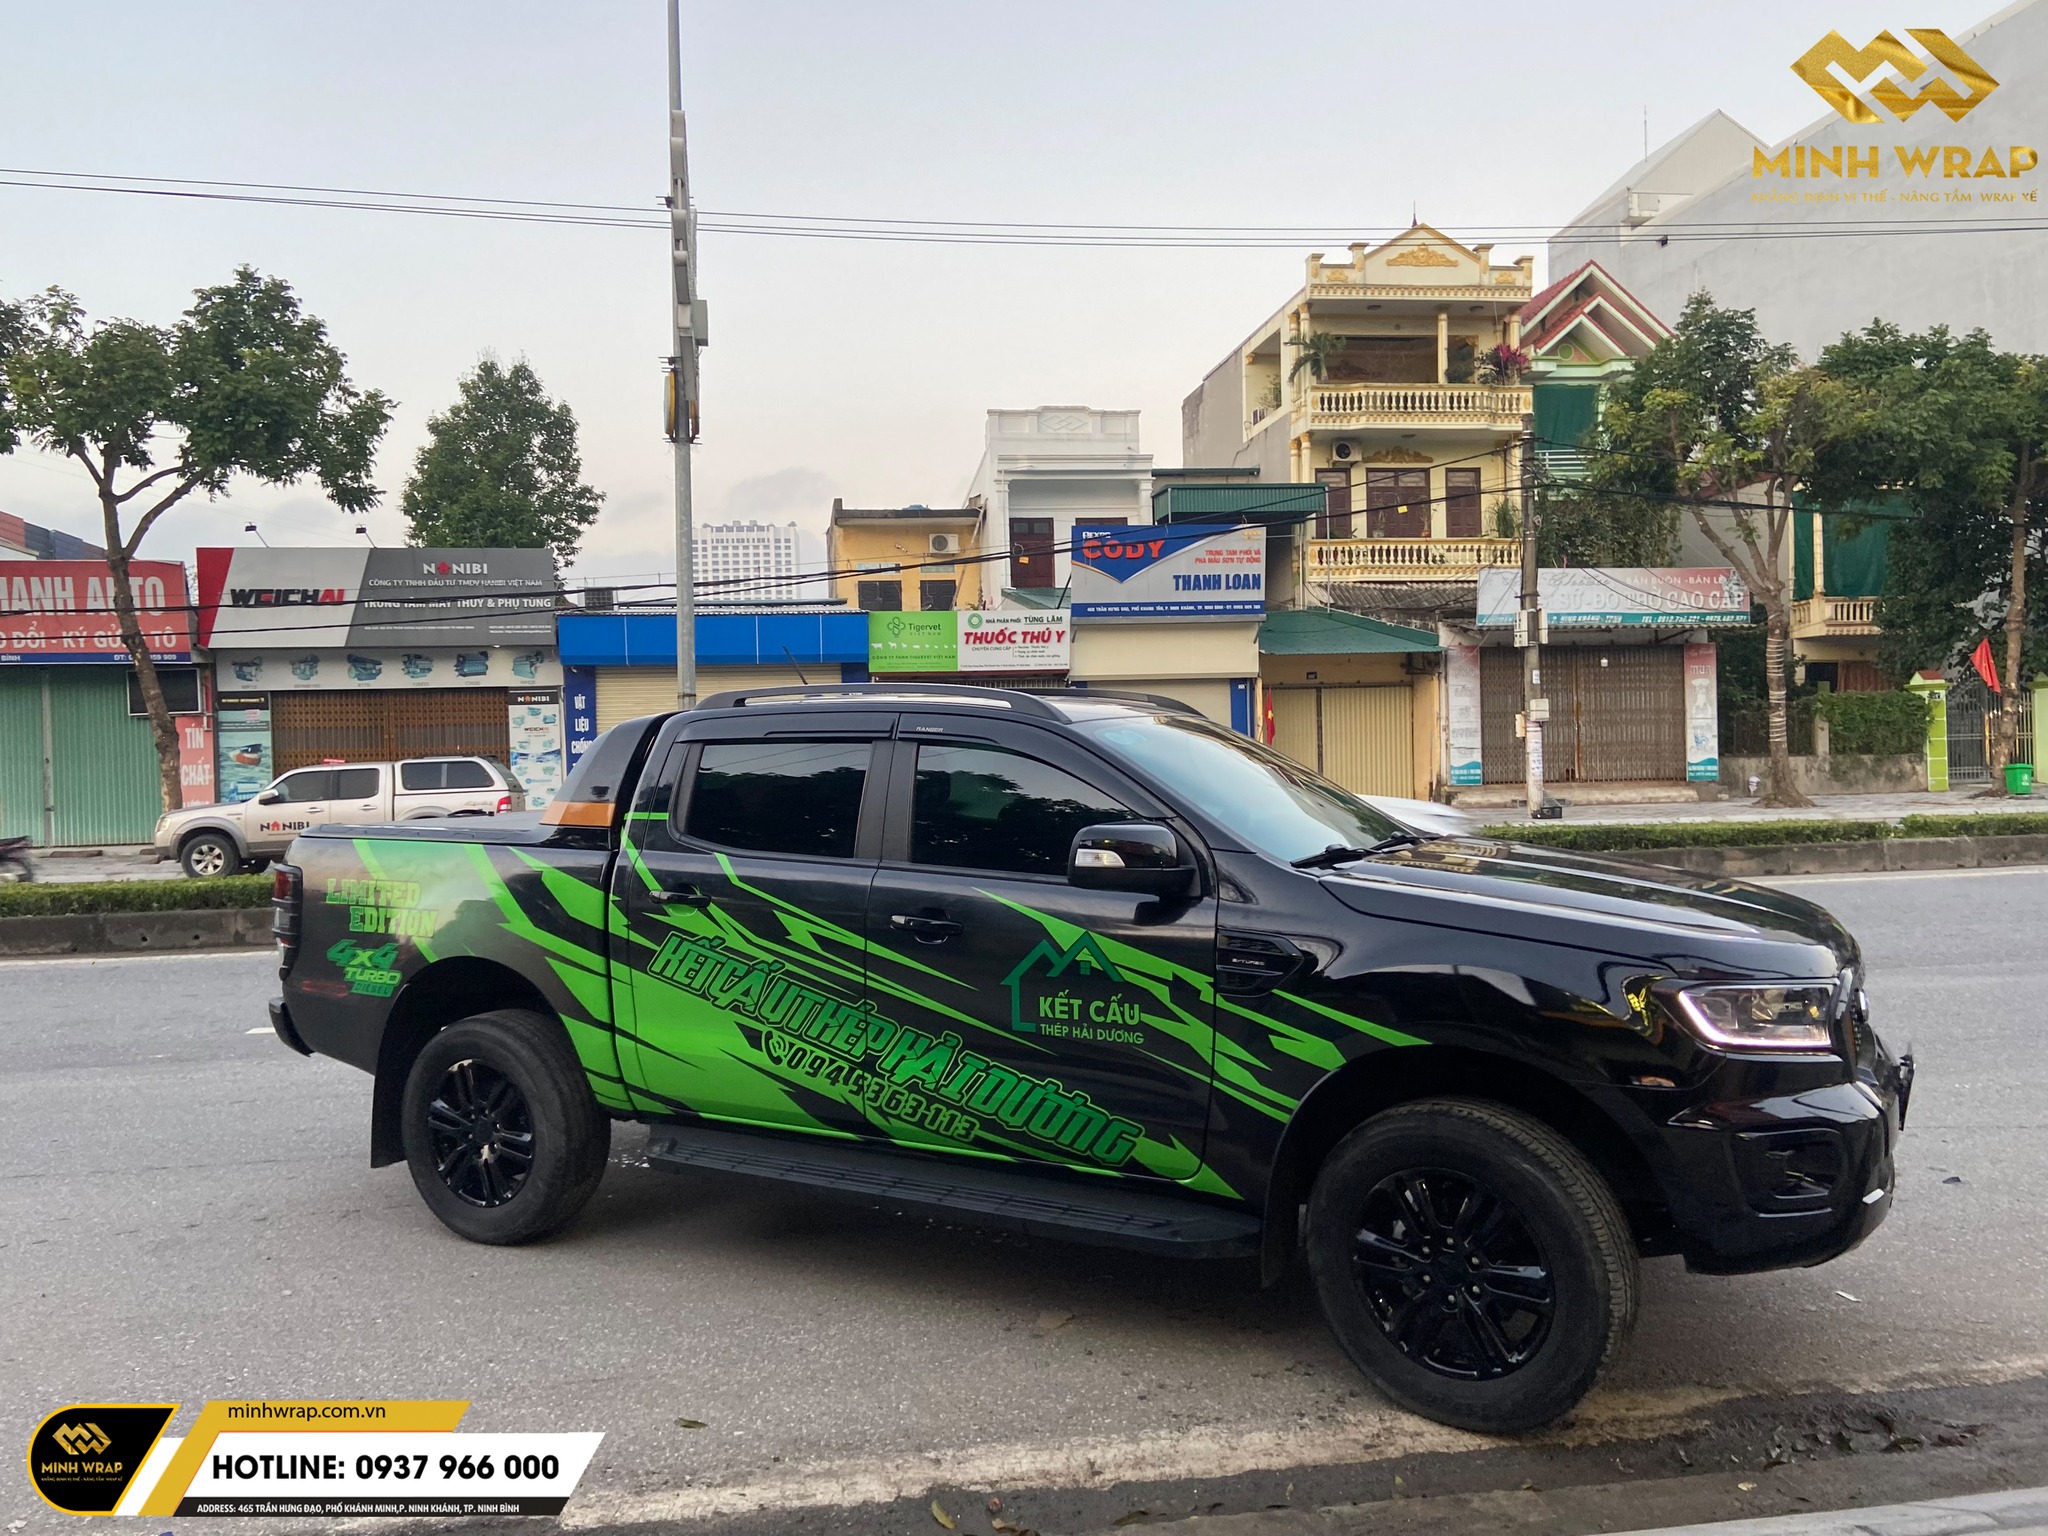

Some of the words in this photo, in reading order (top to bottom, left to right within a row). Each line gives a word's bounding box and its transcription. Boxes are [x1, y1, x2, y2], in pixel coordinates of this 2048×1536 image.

[1083, 540, 1165, 559] CODY
[368, 578, 392, 587] CÔNG
[394, 579, 403, 587] TY
[405, 579, 426, 587] TNHH
[525, 579, 543, 588] NAM
[1173, 573, 1222, 591] THANH
[1225, 573, 1262, 591] LOAN
[230, 588, 345, 608] WEICHAI
[486, 598, 496, 608] &
[497, 598, 520, 610] PHỤ
[1666, 590, 1705, 610] CAO
[908, 623, 942, 632] Tigervet
[1024, 614, 1044, 623] TÙNG
[1046, 614, 1063, 623] LÂM
[12, 621, 46, 649] ĐỔI
[63, 626, 88, 648] KÝ
[153, 626, 177, 649] TÔ
[964, 627, 1017, 645] THUỐC
[1021, 627, 1052, 644] THÚ
[1055, 630, 1066, 643] Y
[1, 652, 21, 662] BÌNH
[184, 723, 205, 750] TÍN
[181, 756, 211, 786] CHẤT
[325, 878, 421, 909] LIMITED
[349, 905, 440, 939] EDITION
[649, 931, 728, 994] KẾT
[344, 966, 402, 986] TURBO
[353, 983, 393, 996] DIESEL
[1039, 989, 1083, 1020] KẾT
[1089, 993, 1140, 1026] CẤU
[1040, 1022, 1070, 1037] THÉP
[1072, 1022, 1093, 1040] HẢI
[1096, 1028, 1145, 1045] DƯƠNG
